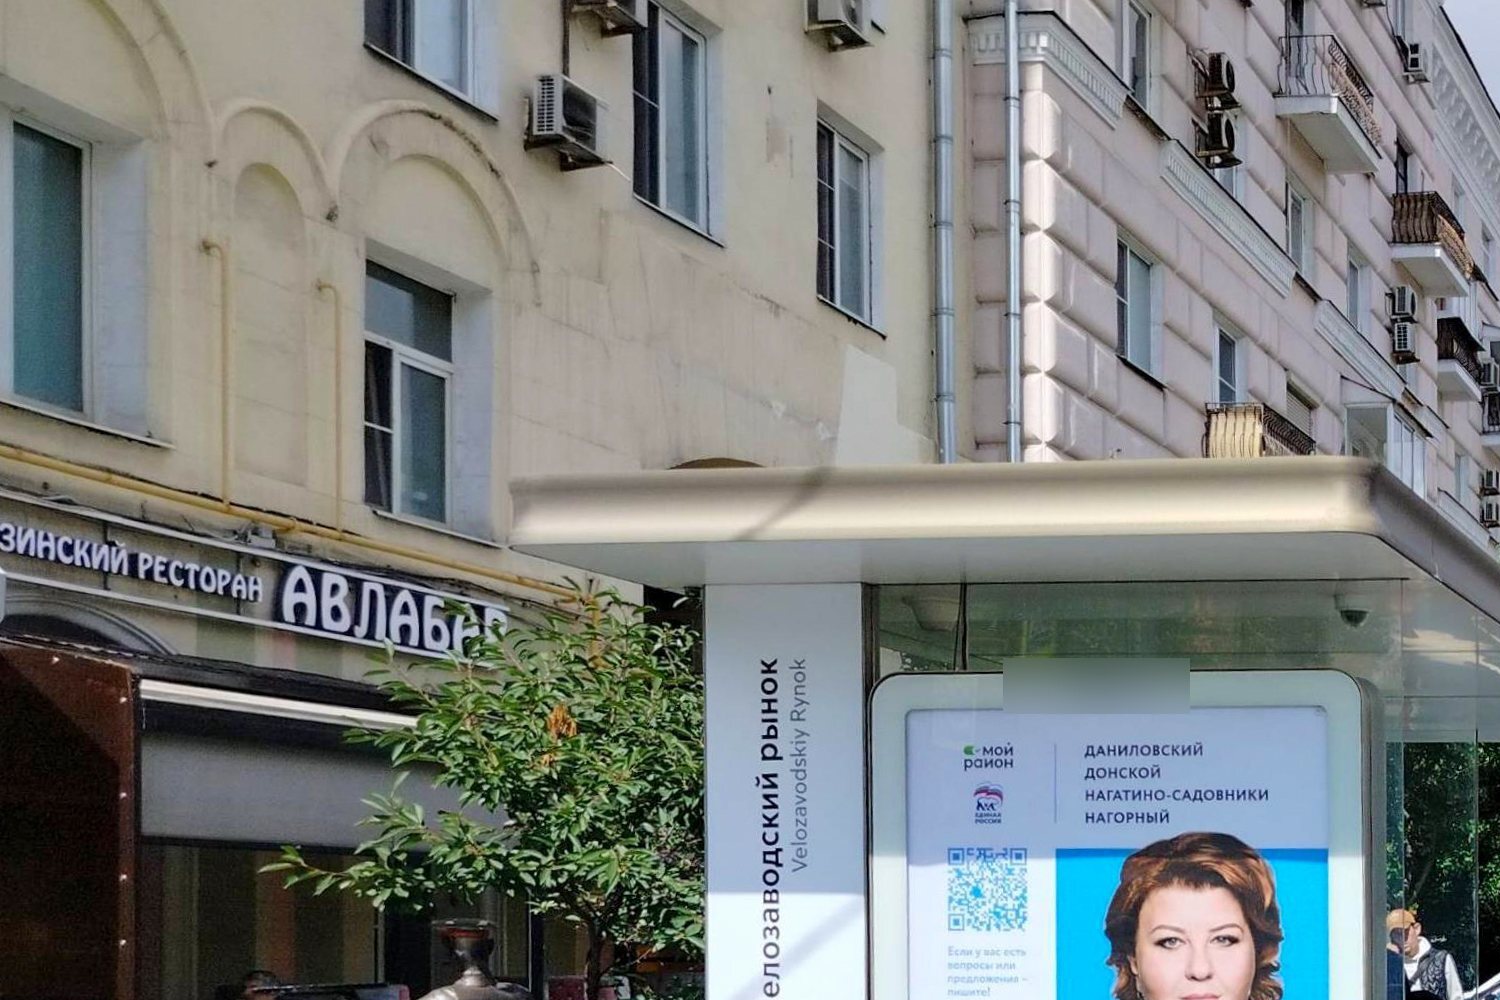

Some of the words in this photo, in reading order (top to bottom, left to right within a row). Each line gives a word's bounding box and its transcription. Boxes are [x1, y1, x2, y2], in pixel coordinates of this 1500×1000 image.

[137, 552, 263, 602] РЕСТОРАН
[788, 659, 810, 721] Rynok
[759, 658, 784, 761] рынок
[982, 741, 1014, 756] мой
[1084, 742, 1204, 758] ДАНИЛОВСКИЙ
[1084, 765, 1161, 781] ДОНСКОЙ
[788, 728, 810, 873] Velozavodskiy
[1085, 789, 1270, 803] НАГАТИНО-САДОВНИКИ
[1085, 809, 1171, 824] НАГОРНЫЙ
[947, 945, 973, 957] Если
[983, 949, 1002, 957] вас
[1003, 949, 1027, 957] есть
[947, 962, 993, 972] вопросы
[995, 962, 1016, 970] или
[947, 986, 991, 997] пишите!
